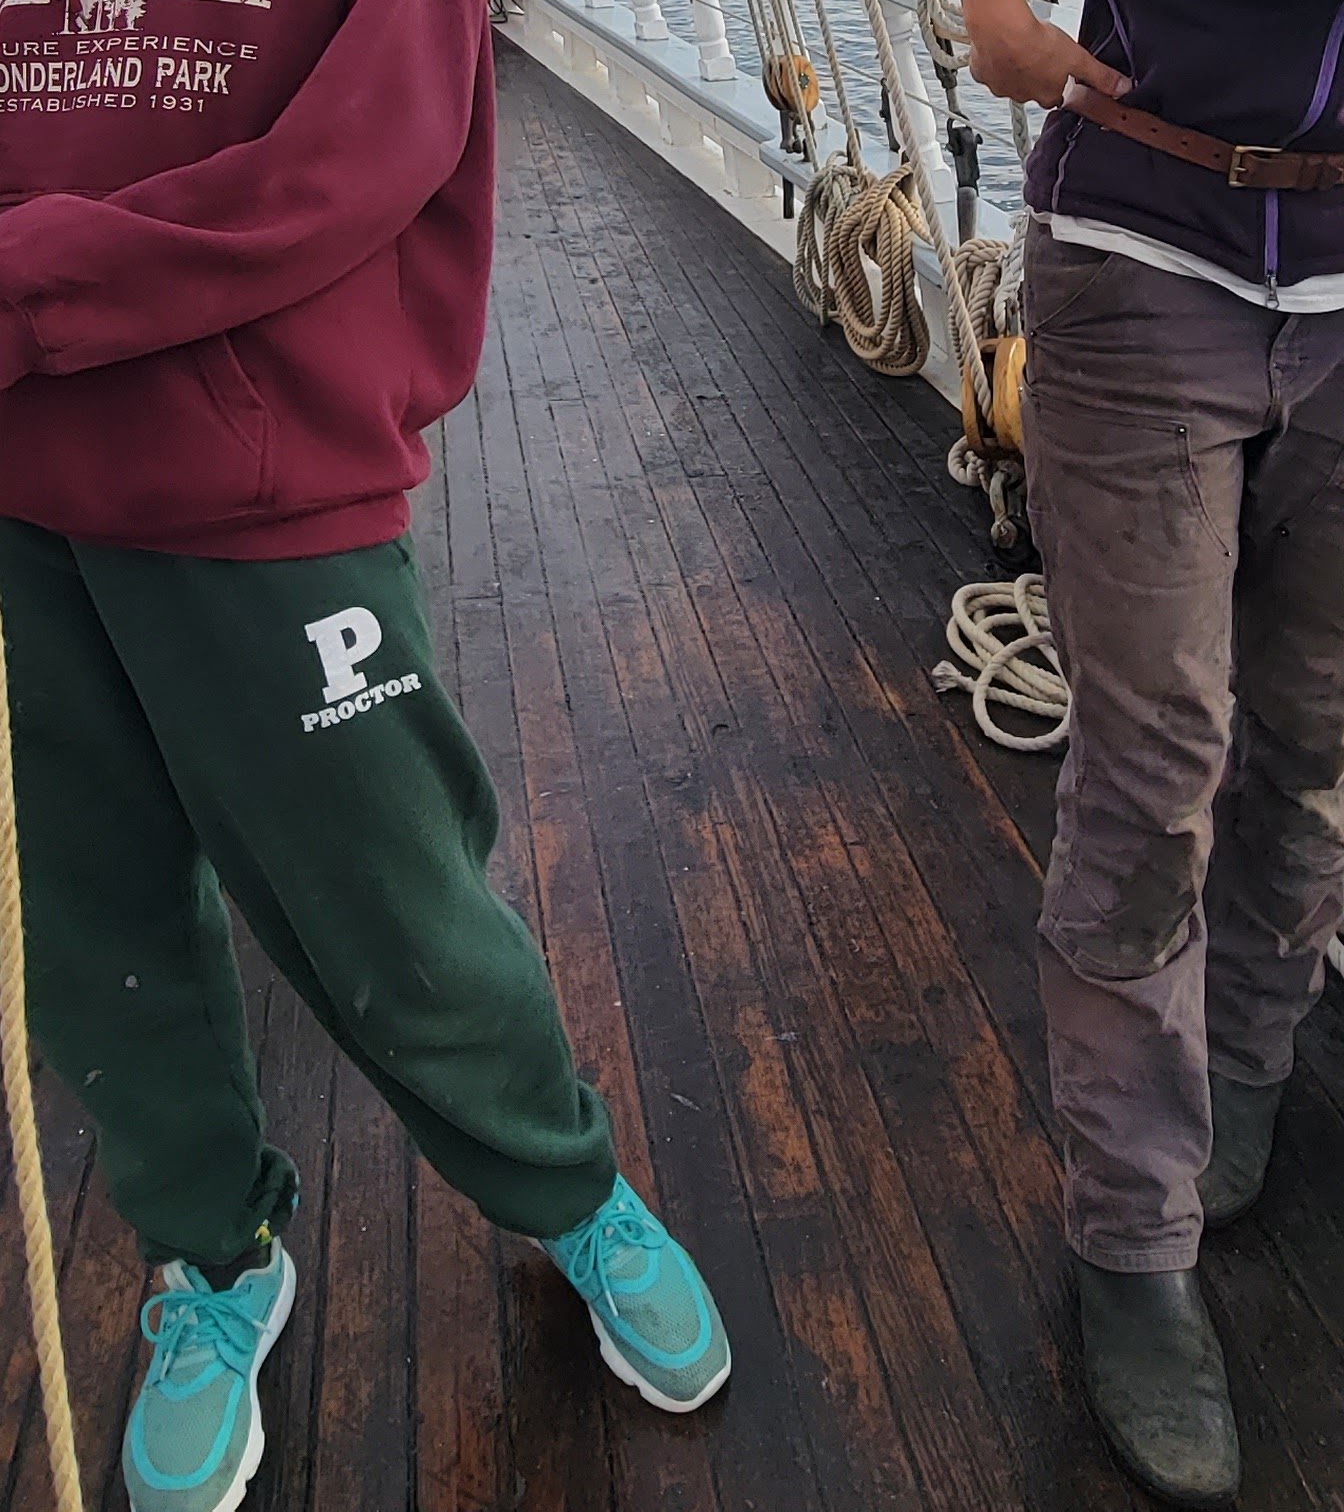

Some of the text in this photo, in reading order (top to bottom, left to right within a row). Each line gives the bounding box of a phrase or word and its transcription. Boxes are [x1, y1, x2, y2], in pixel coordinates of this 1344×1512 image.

[76, 36, 259, 60] EXPERIENCE
[155, 56, 233, 95] PARK
[149, 94, 205, 113] 1931
[304, 606, 382, 704] P
[301, 673, 422, 732] PROCTOR
